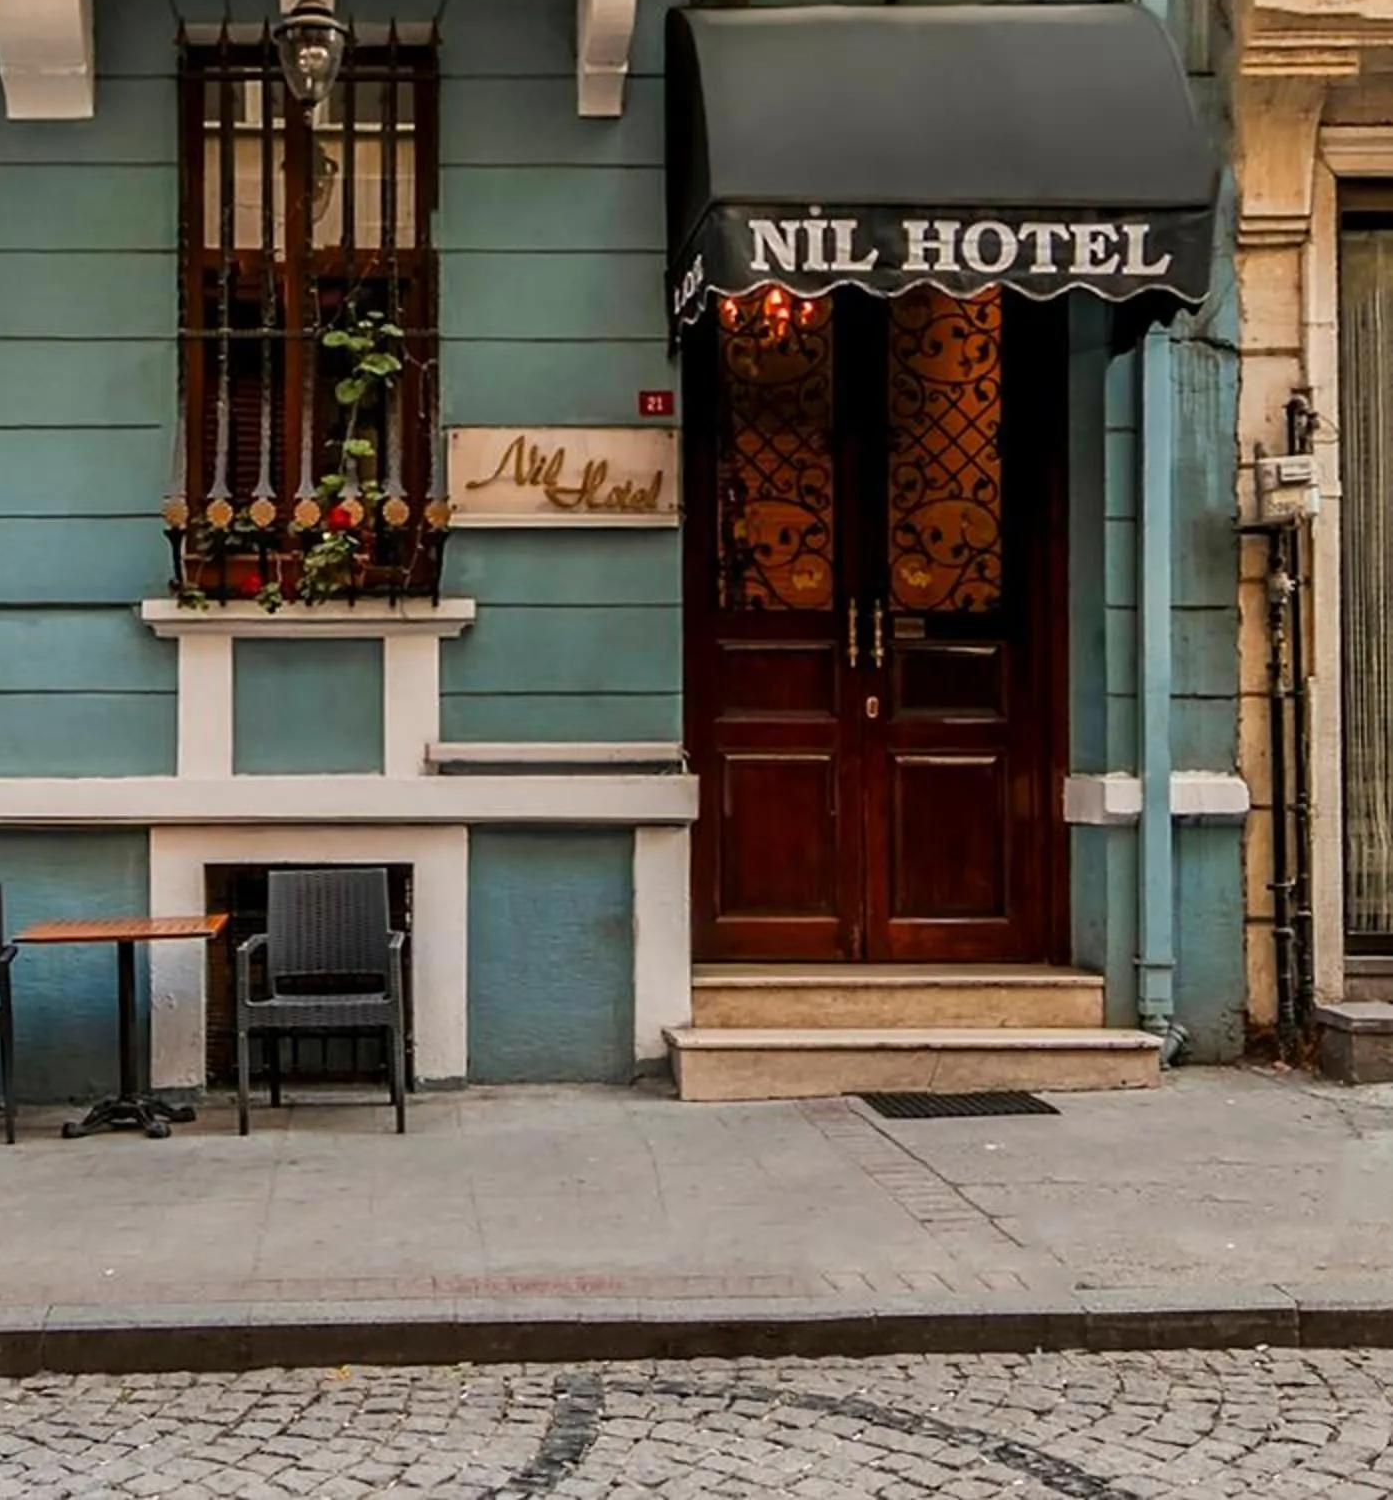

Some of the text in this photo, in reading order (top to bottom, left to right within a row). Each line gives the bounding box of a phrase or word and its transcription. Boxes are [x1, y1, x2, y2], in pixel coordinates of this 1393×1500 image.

[748, 205, 1174, 275] NİL HOTEL
[647, 395, 663, 412] 21
[465, 434, 664, 509] Nil Hotel
